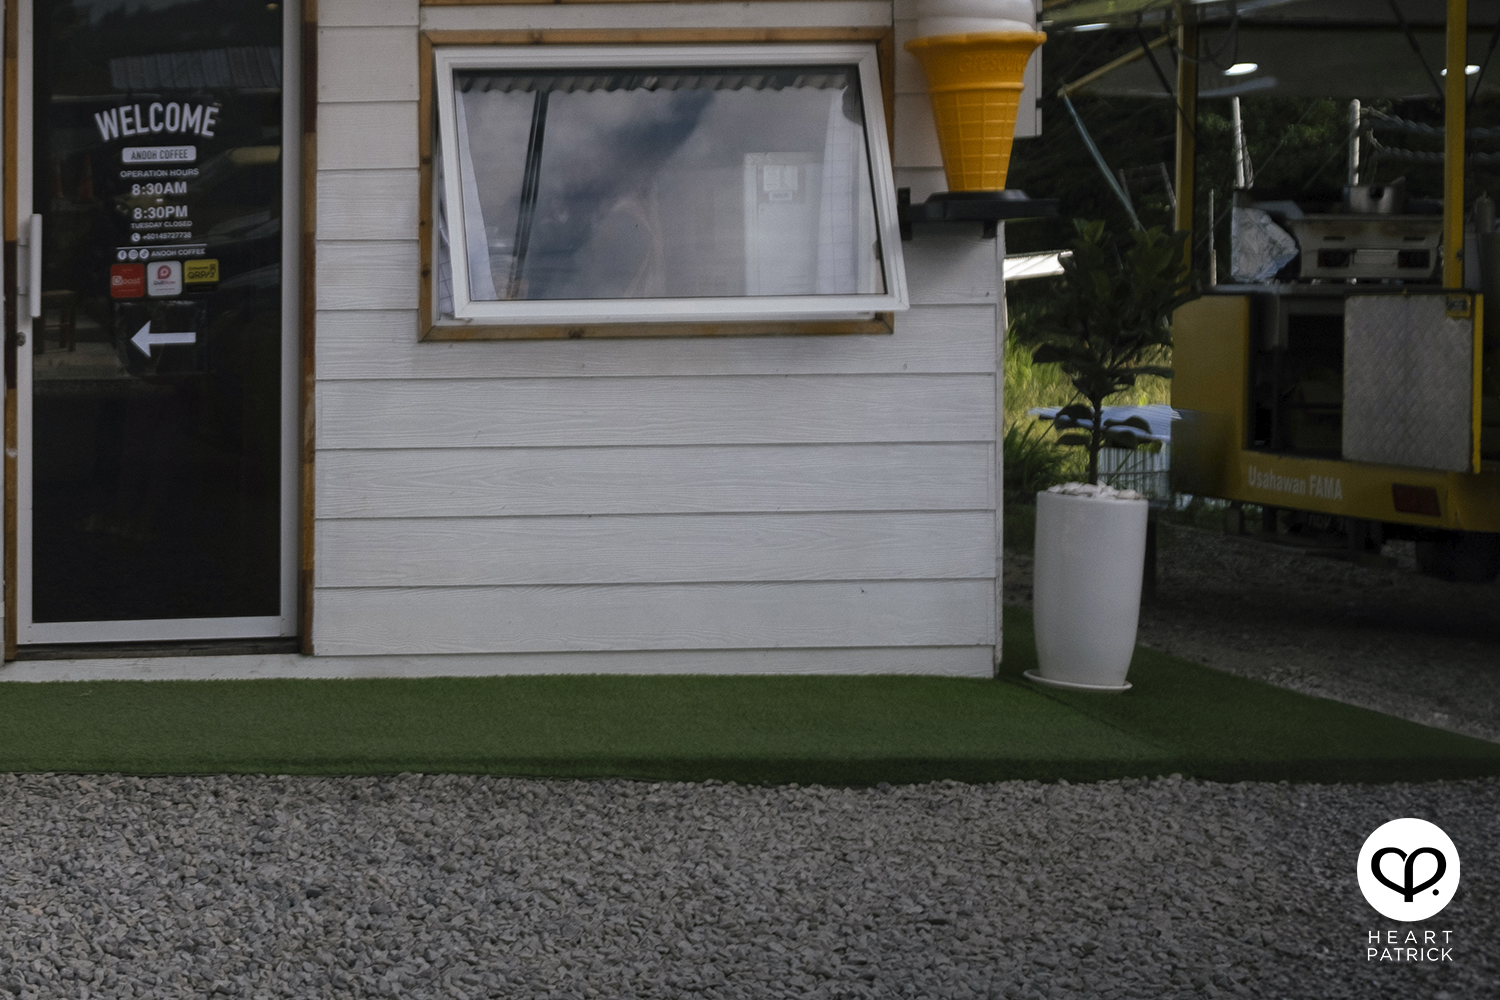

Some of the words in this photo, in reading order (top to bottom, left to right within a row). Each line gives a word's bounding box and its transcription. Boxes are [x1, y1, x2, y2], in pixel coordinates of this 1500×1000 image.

[94, 101, 220, 142] WELCOME
[131, 150, 157, 160] ANOOH
[159, 149, 188, 160] COFFEE
[120, 169, 168, 178] OPERATION
[170, 168, 199, 177] HOURS
[132, 181, 187, 196] 8:30AM
[133, 205, 188, 219] 8:30PM
[151, 249, 177, 257] ANOOH
[178, 248, 206, 256] COFFEE
[1248, 464, 1307, 496] Usahawan
[1309, 474, 1343, 501] FAMA
